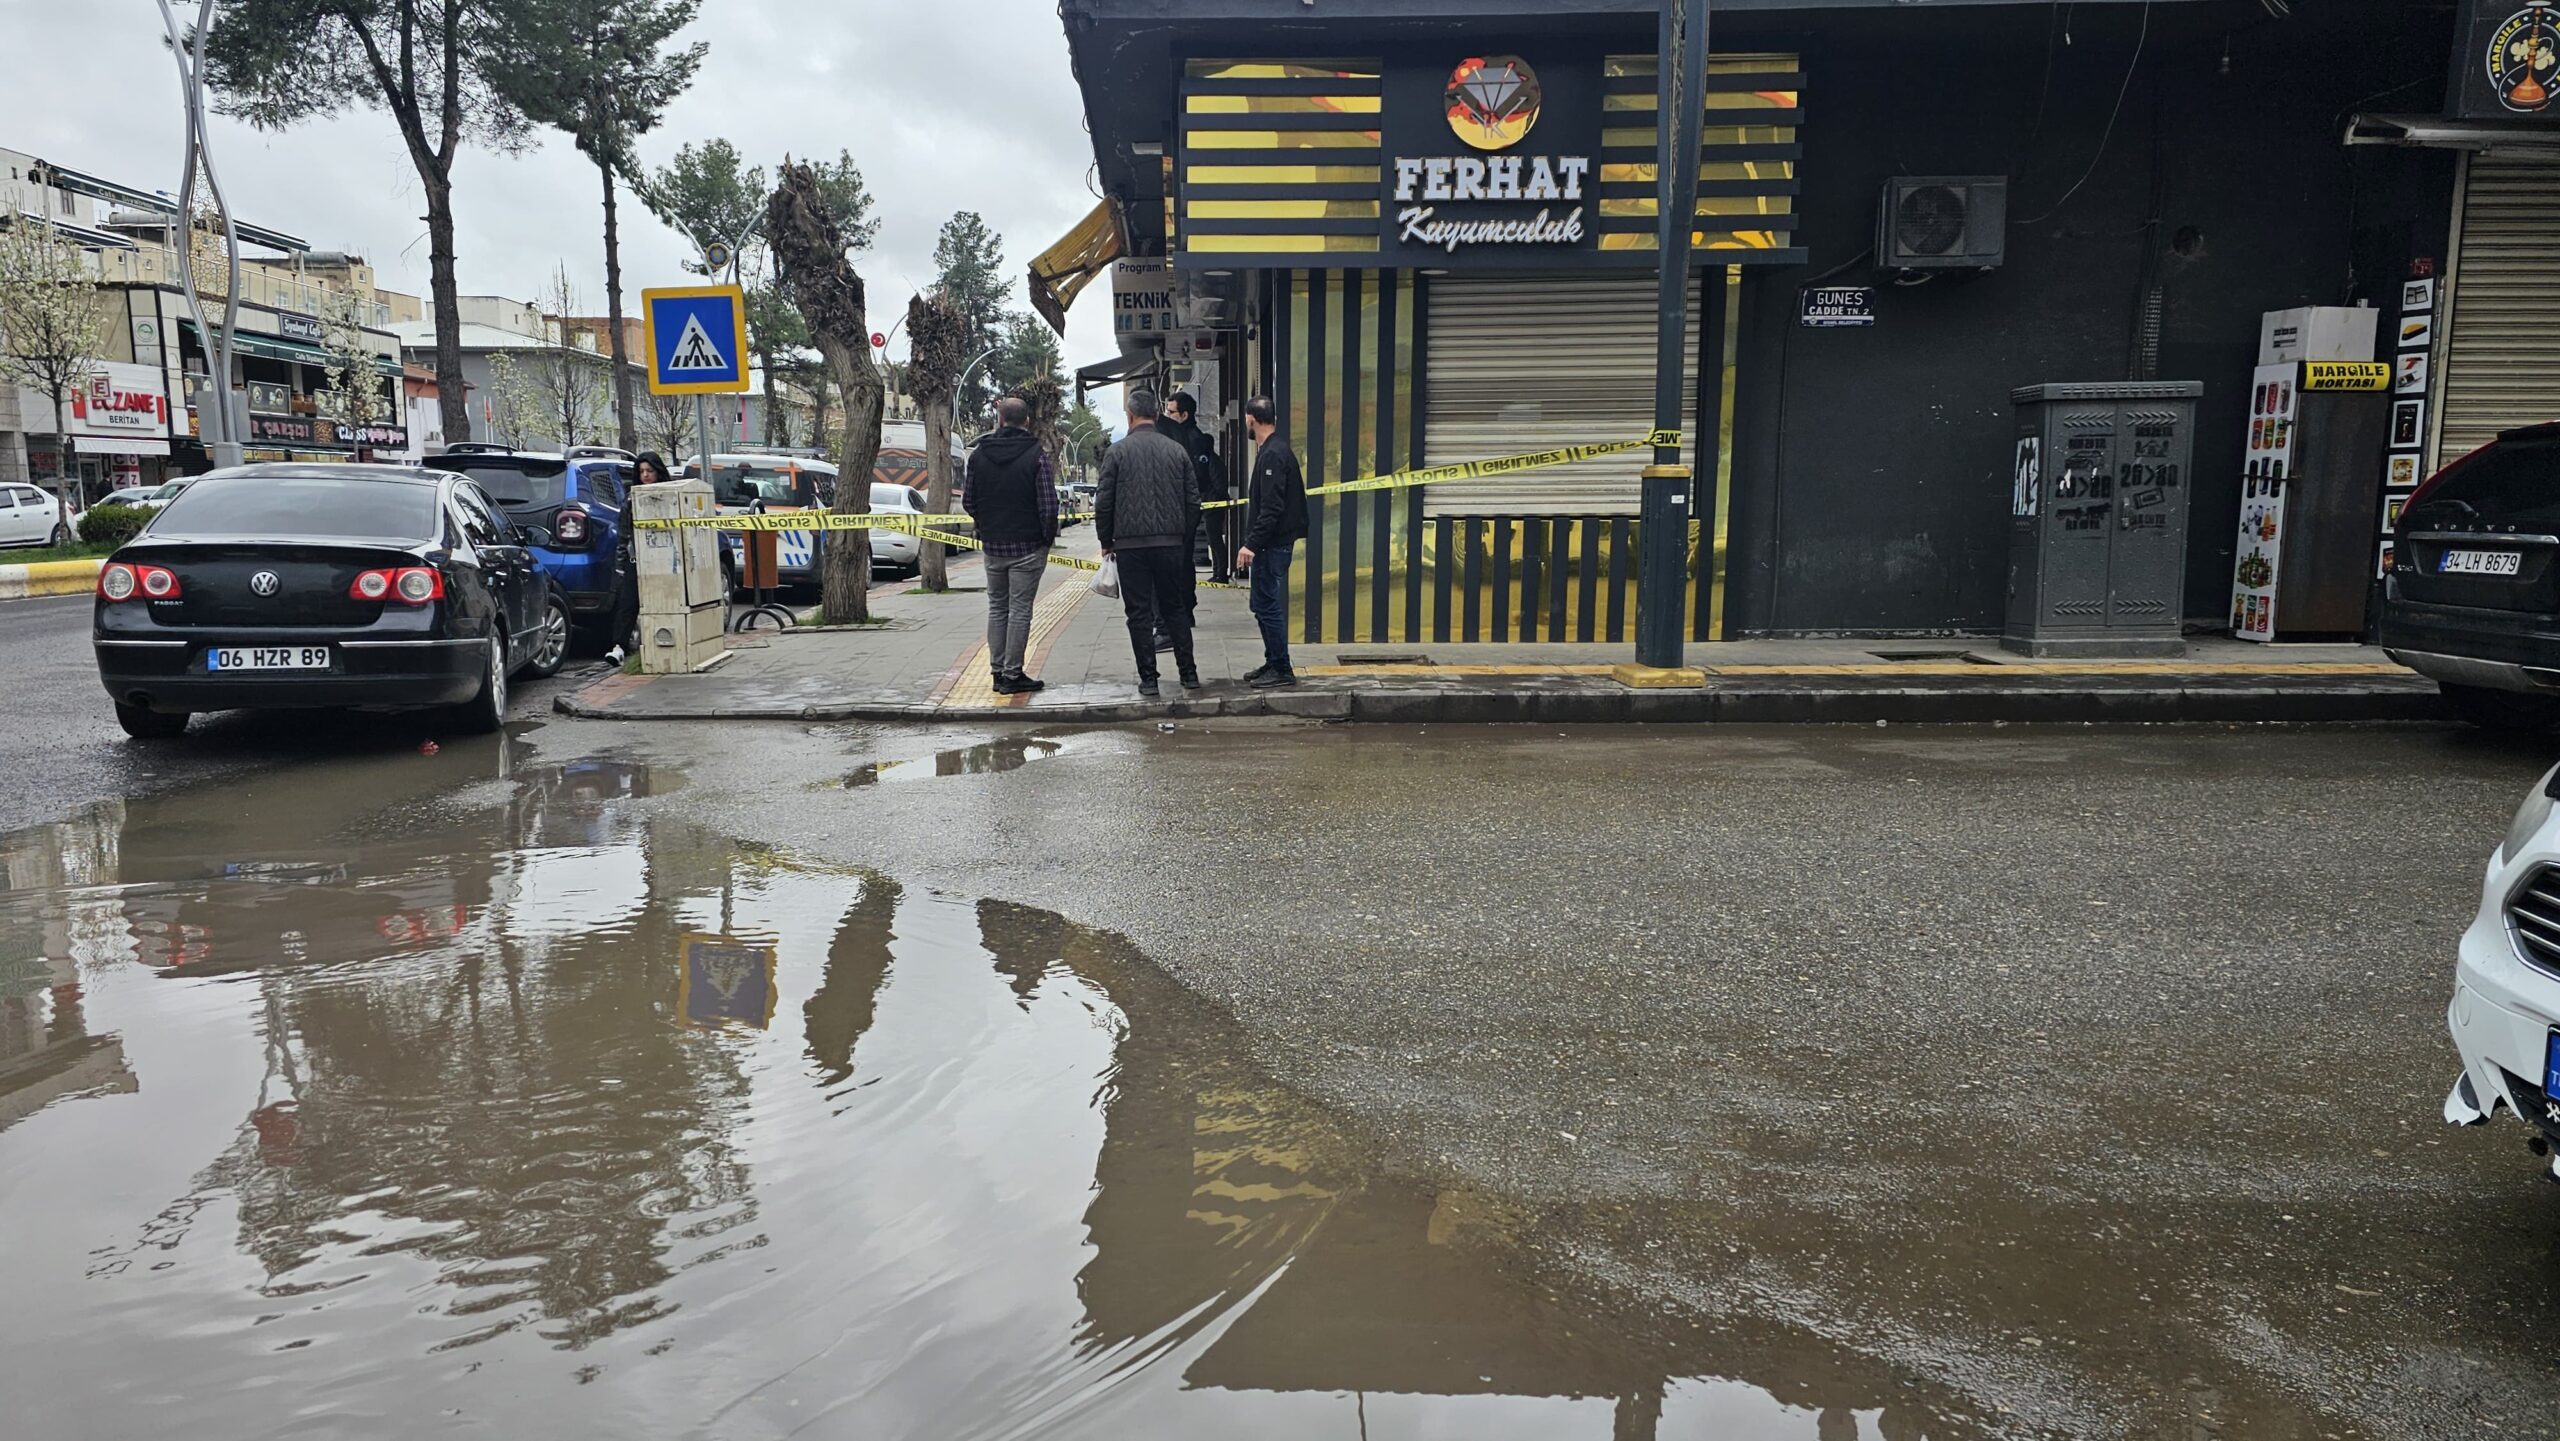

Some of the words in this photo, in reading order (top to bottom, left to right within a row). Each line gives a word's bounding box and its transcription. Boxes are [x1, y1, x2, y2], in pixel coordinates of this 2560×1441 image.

[1394, 156, 1590, 202] FERHAT
[1397, 206, 1585, 253] Kuyumculuk
[1118, 262, 1161, 275] Program
[1808, 306, 1844, 315] CADDE
[2312, 363, 2385, 378] NARGİLE
[2314, 378, 2376, 389] NOKTASI
[109, 414, 140, 425] BERİTAN
[2434, 523, 2516, 532] VOLVO
[2446, 553, 2461, 570] 34
[2465, 553, 2482, 570] LH
[2485, 554, 2518, 572] 8679
[218, 650, 244, 667] 06
[253, 650, 291, 667] HZR
[301, 648, 327, 665] 89
